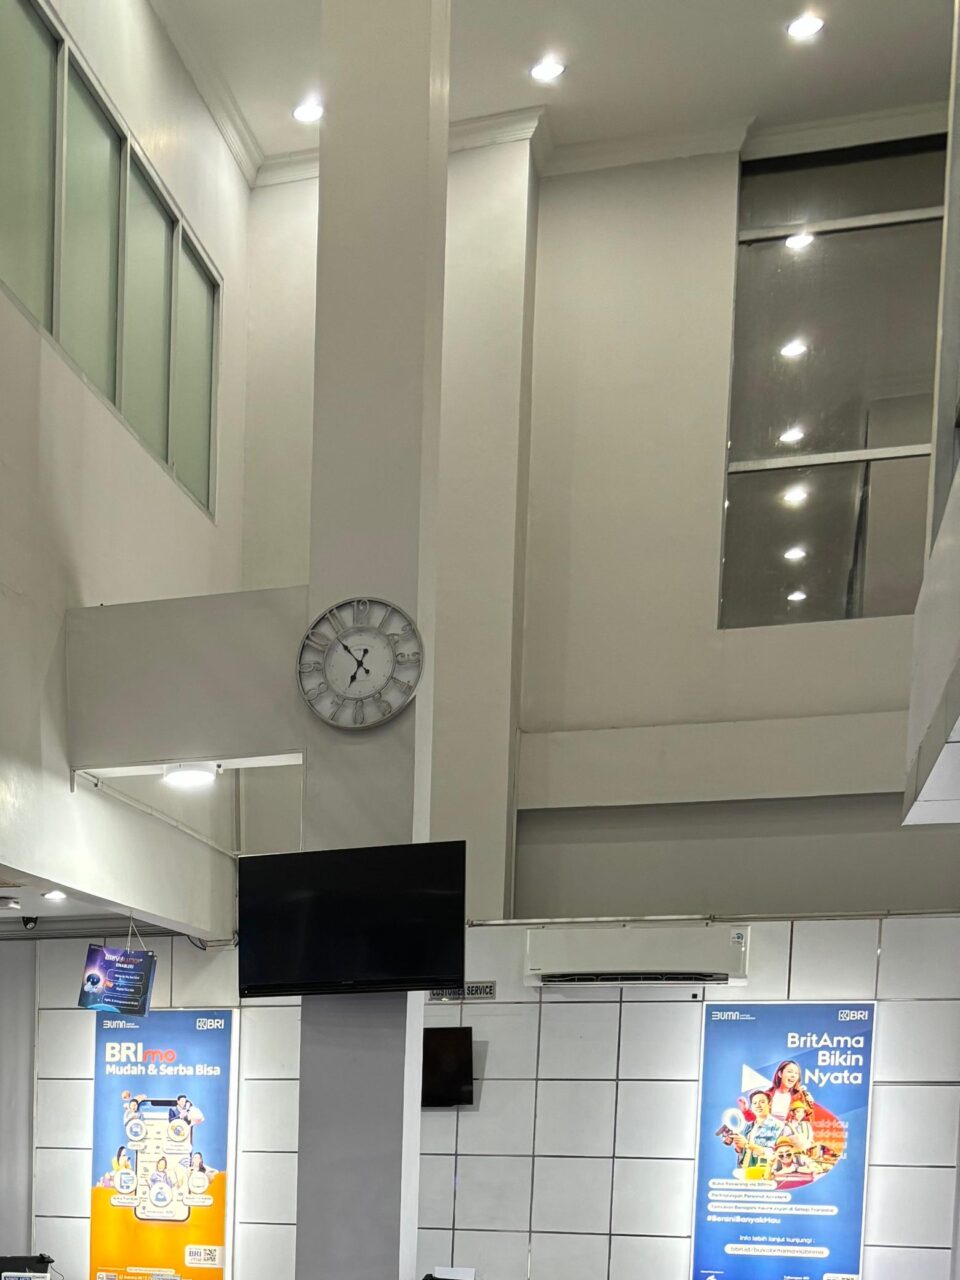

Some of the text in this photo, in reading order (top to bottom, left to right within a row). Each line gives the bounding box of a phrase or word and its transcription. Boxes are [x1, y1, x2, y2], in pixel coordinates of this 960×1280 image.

[466, 985, 493, 996] SERVICE
[850, 1010, 868, 1020] BRI
[207, 1019, 224, 1029] BRI
[787, 1032, 864, 1048] BritAma
[105, 1042, 176, 1063] BRImo
[817, 1050, 863, 1066] Bikin
[105, 1064, 221, 1076] Mudah & Serba Bisa
[805, 1069, 863, 1087] Nyata
